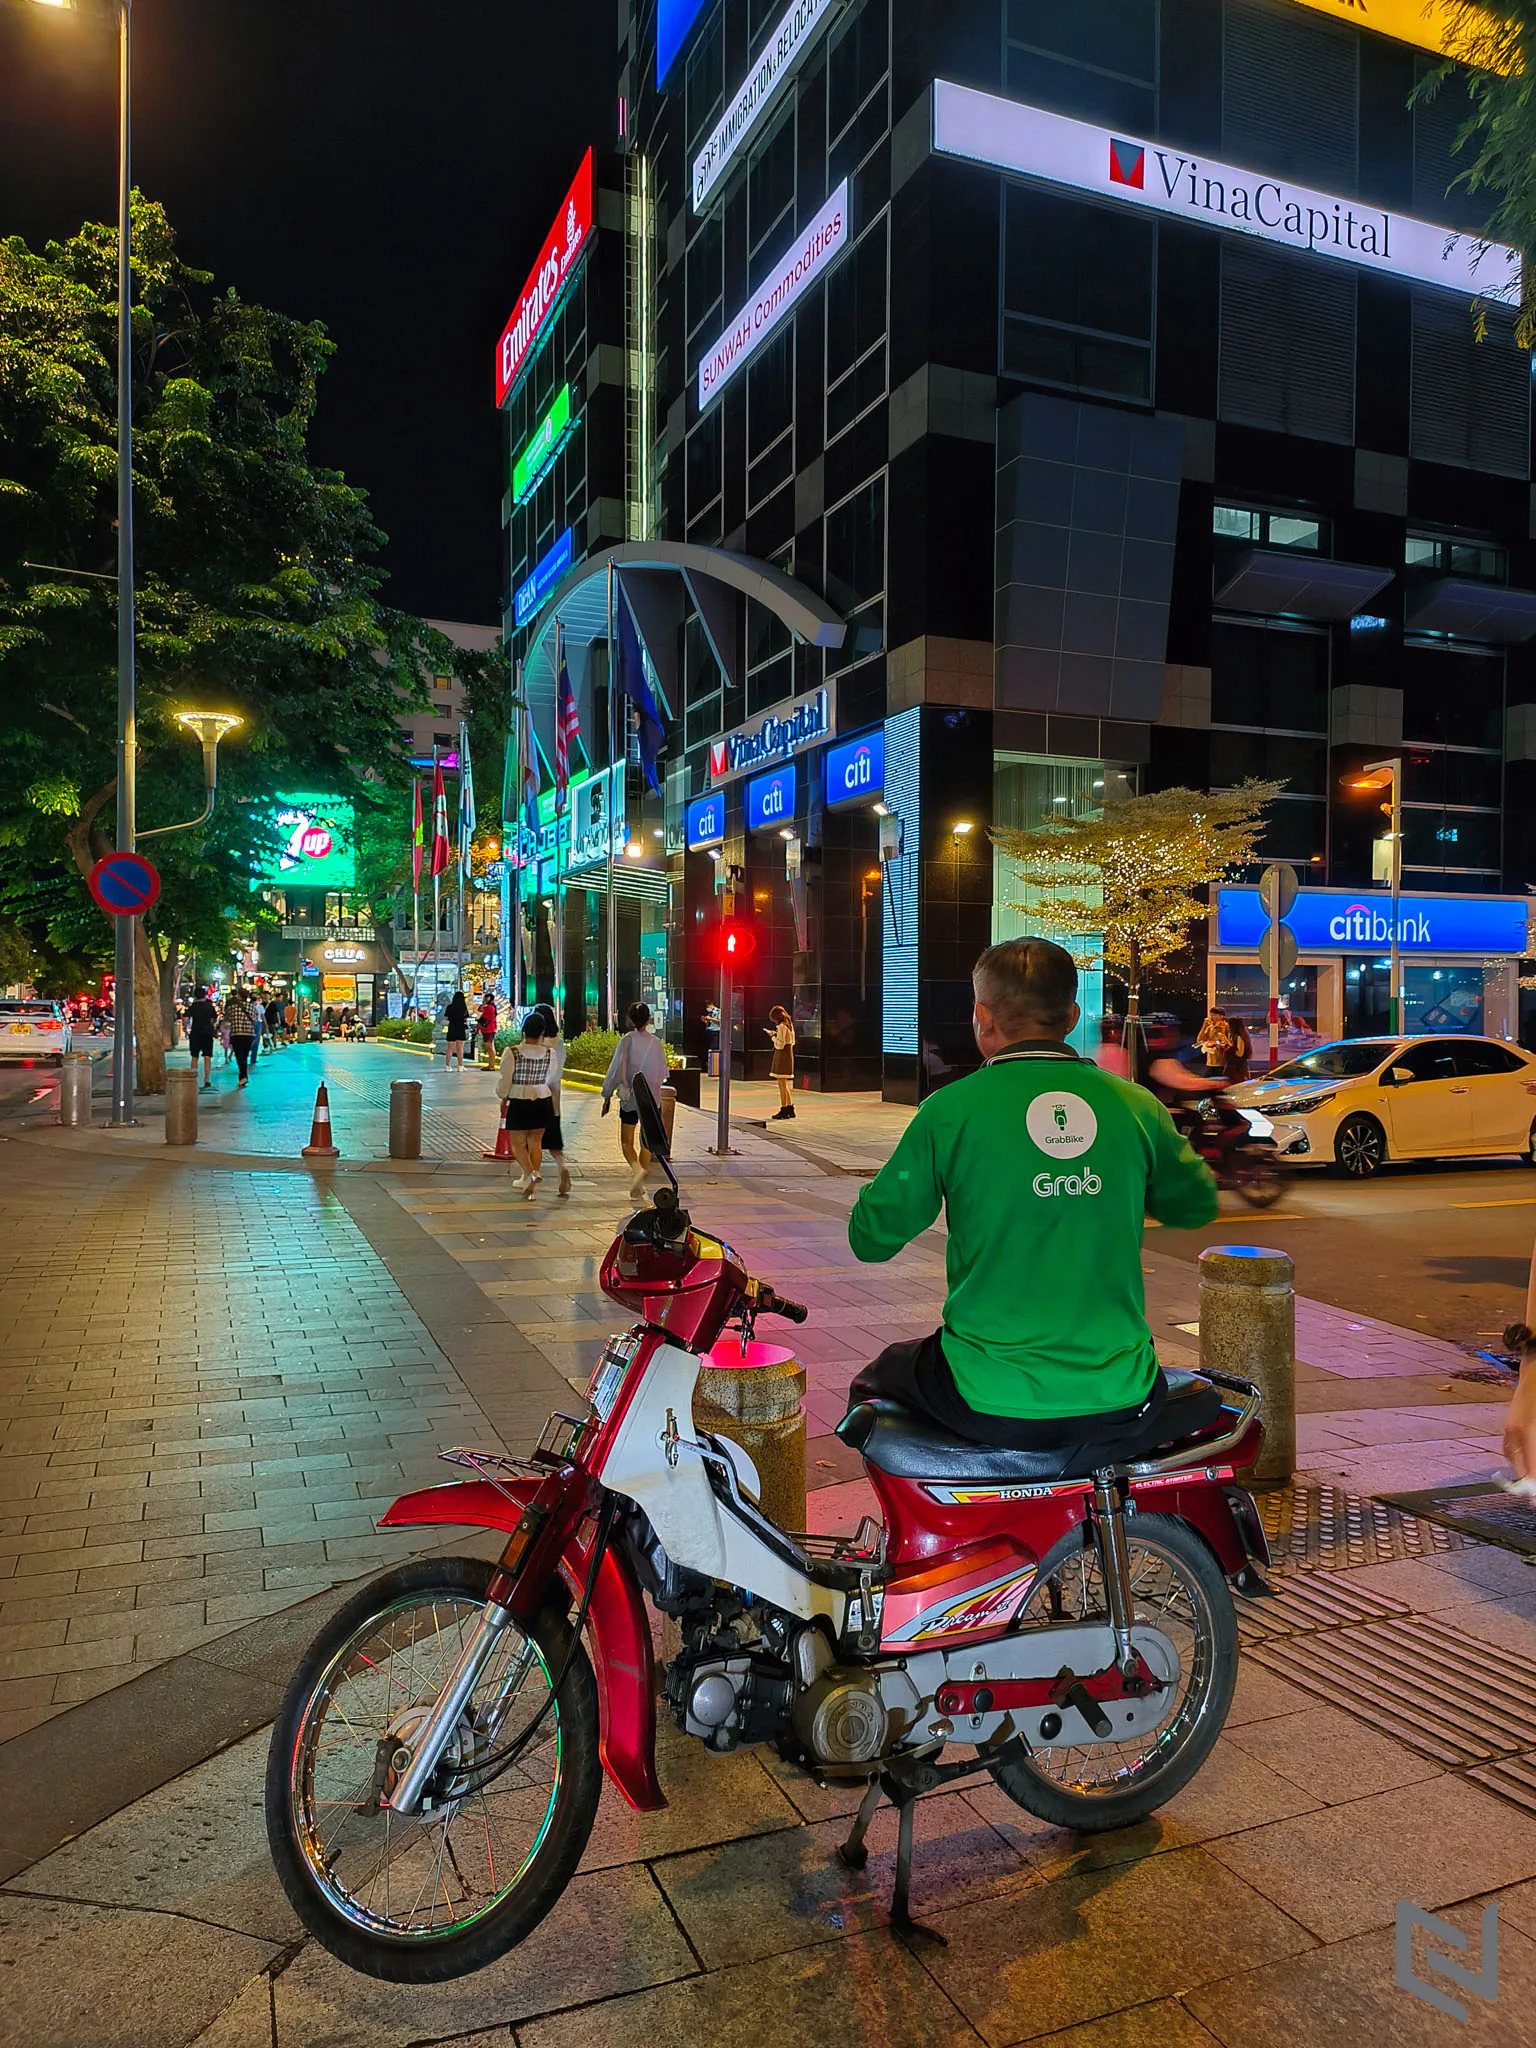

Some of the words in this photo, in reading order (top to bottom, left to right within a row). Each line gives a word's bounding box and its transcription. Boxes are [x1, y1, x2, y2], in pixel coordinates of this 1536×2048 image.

[719, 53, 773, 160] IMMIGRATION
[1152, 150, 1392, 258] VinaCapital
[502, 246, 558, 384] Emirates
[703, 317, 750, 391] SUNWAH
[754, 212, 842, 329] Commodities
[844, 751, 871, 789] citi
[762, 785, 783, 816] citi
[698, 810, 715, 837] citi
[1045, 1136, 1084, 1144] GrabBike
[1032, 1166, 1102, 1197] Grab
[1000, 1487, 1053, 1499] HONDA
